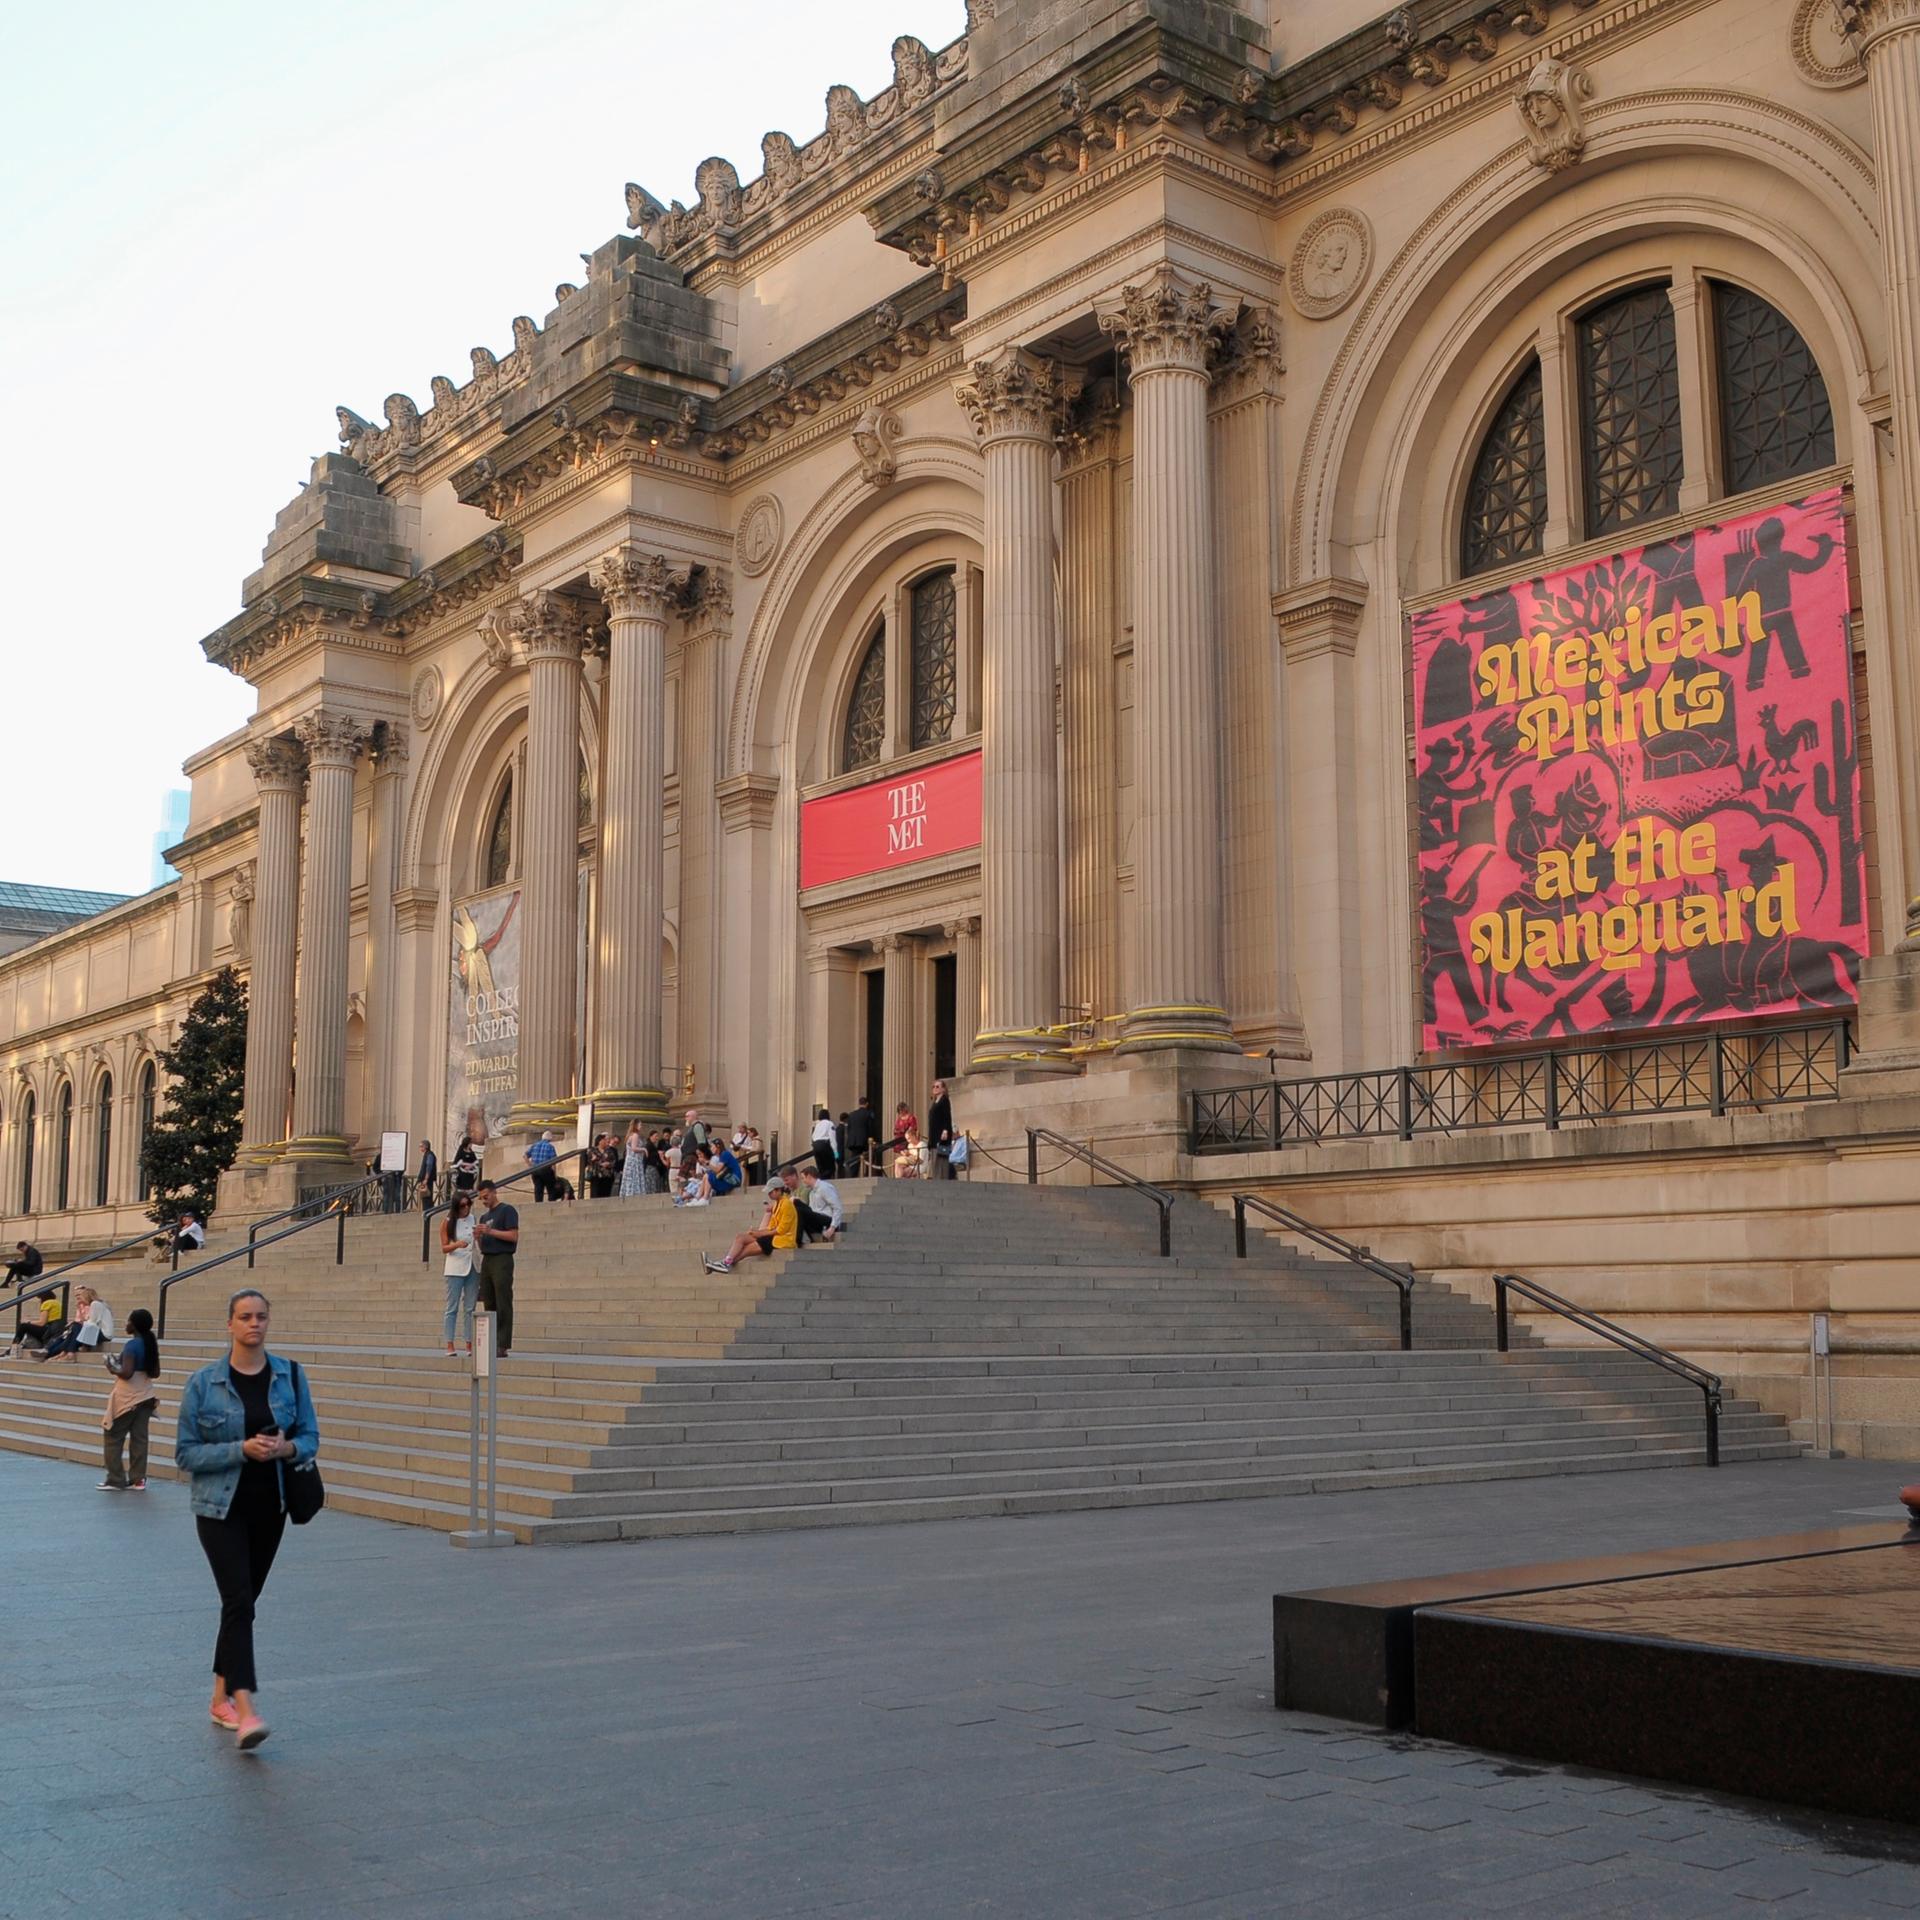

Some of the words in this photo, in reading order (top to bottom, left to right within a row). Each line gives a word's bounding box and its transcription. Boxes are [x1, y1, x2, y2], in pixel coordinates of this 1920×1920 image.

[1477, 591, 1767, 704] Mexican
[1516, 671, 1727, 761] Prints
[887, 781, 927, 820] THE
[887, 815, 928, 855] MET
[1535, 834, 1598, 901] at
[1609, 815, 1716, 884] the
[1471, 863, 1799, 974] Vanguard
[465, 1054, 510, 1077] EDWARD
[467, 1080, 481, 1096] AT
